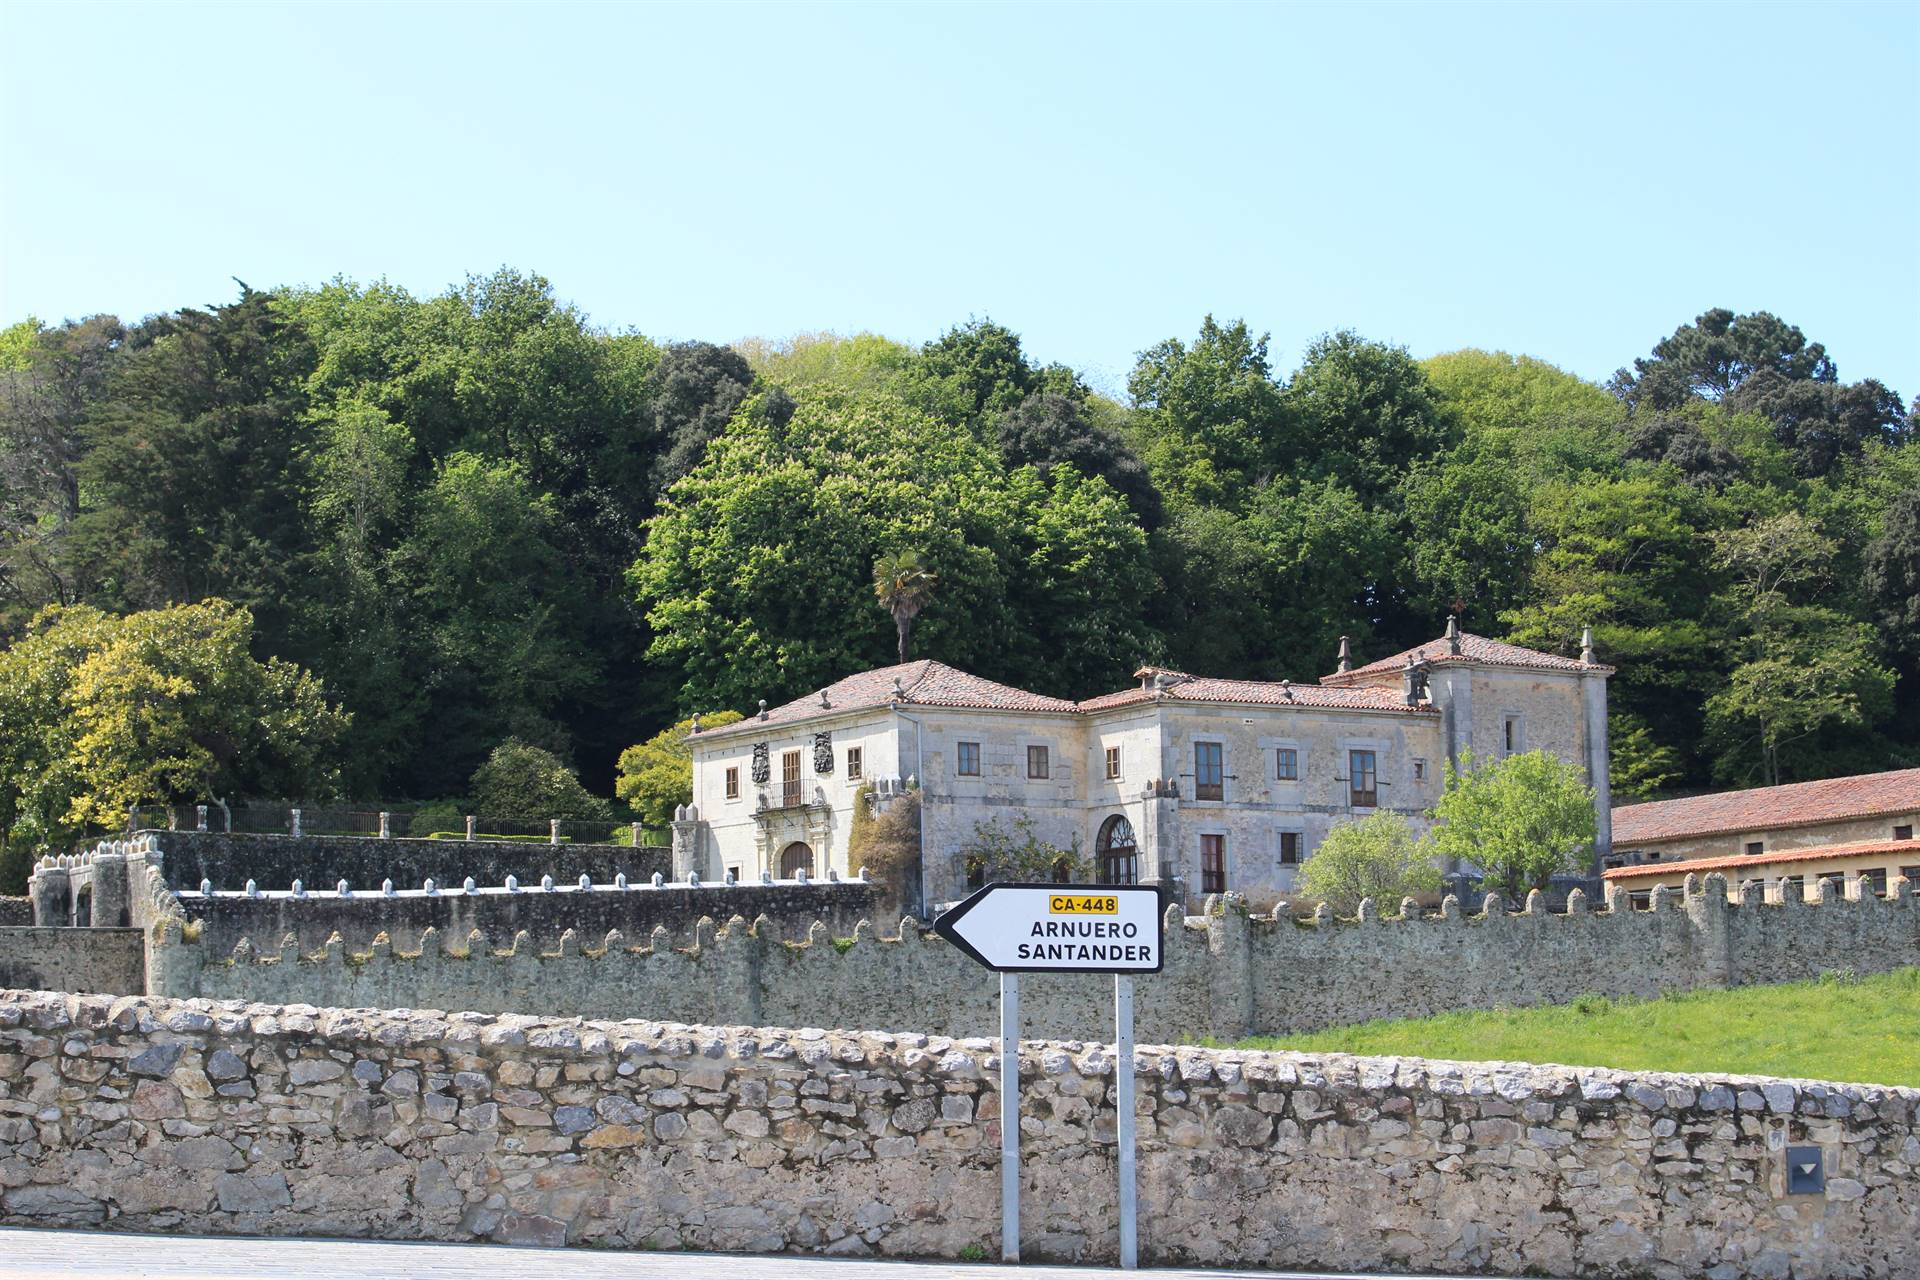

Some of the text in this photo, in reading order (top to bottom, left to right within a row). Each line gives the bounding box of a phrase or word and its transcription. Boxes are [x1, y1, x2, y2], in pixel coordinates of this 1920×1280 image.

[1052, 898, 1115, 911] CA-448
[1030, 921, 1138, 938] ARNUERO
[1017, 943, 1151, 961] SANTANDER
